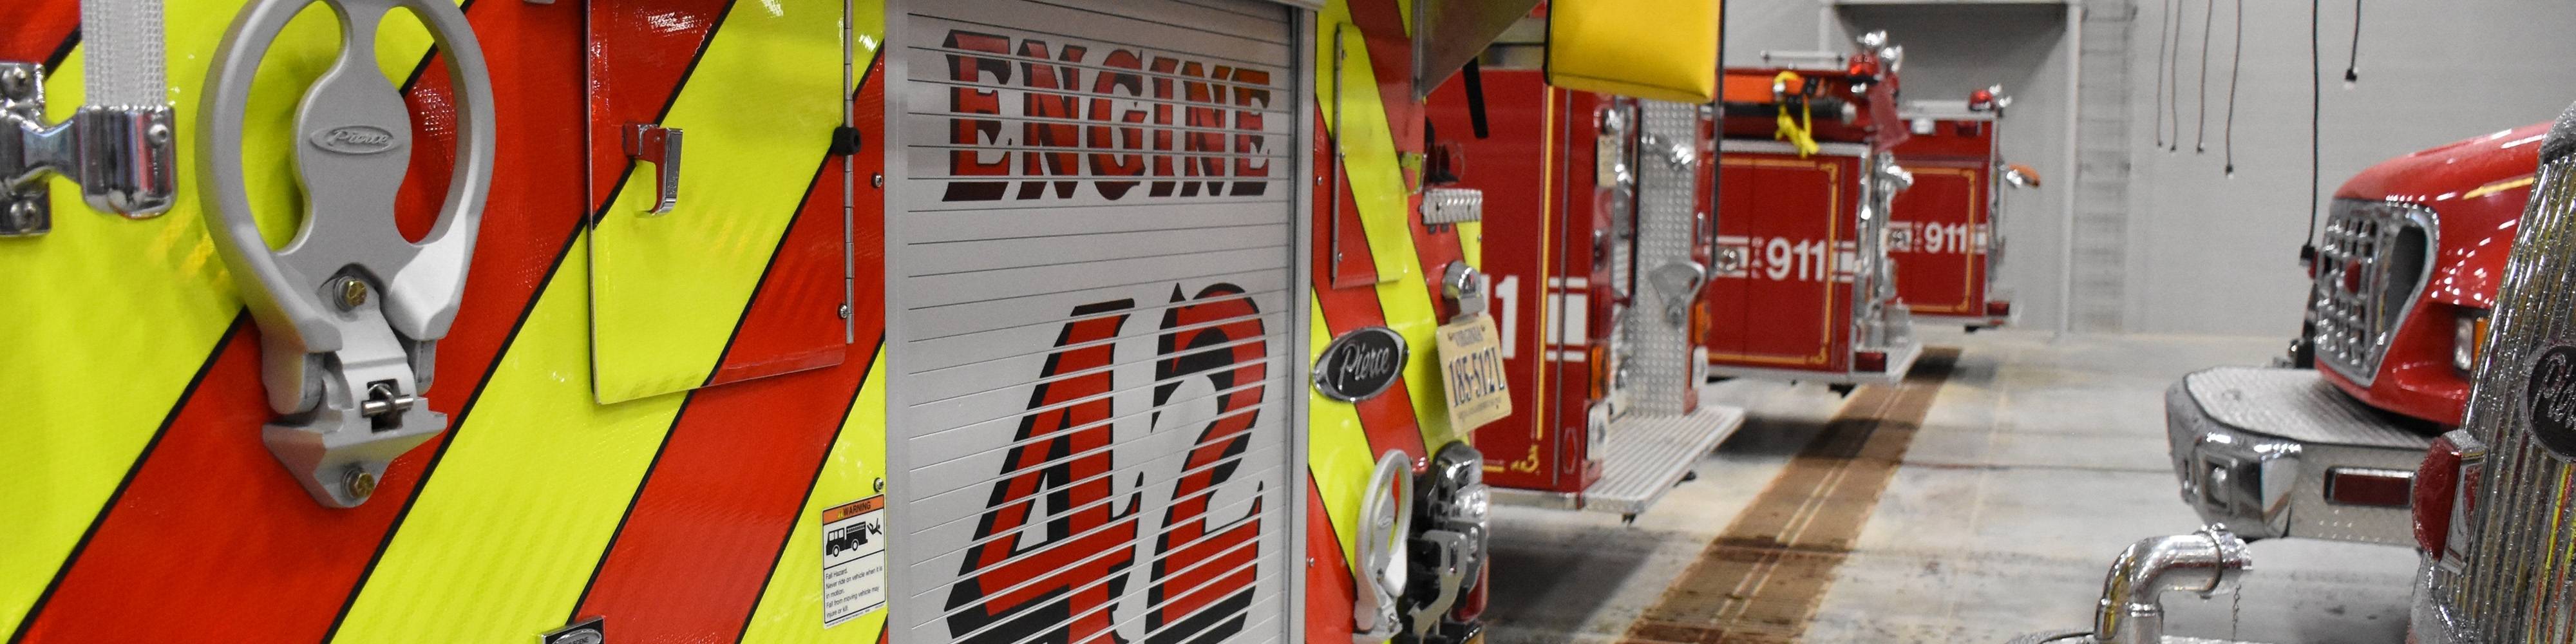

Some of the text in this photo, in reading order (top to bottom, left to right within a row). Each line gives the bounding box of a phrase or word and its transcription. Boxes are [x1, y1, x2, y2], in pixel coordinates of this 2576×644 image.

[943, 29, 1270, 200] ENGINE
[1924, 222, 1967, 253] 911
[1766, 236, 1826, 281] 911
[1338, 343, 1390, 390] Pierce
[945, 282, 1267, 644] 42
[843, 501, 871, 516] WARNING
[852, 571, 865, 580] vehicle
[844, 593, 858, 602] moving
[858, 588, 871, 596] vehicle
[826, 609, 837, 618] injure
